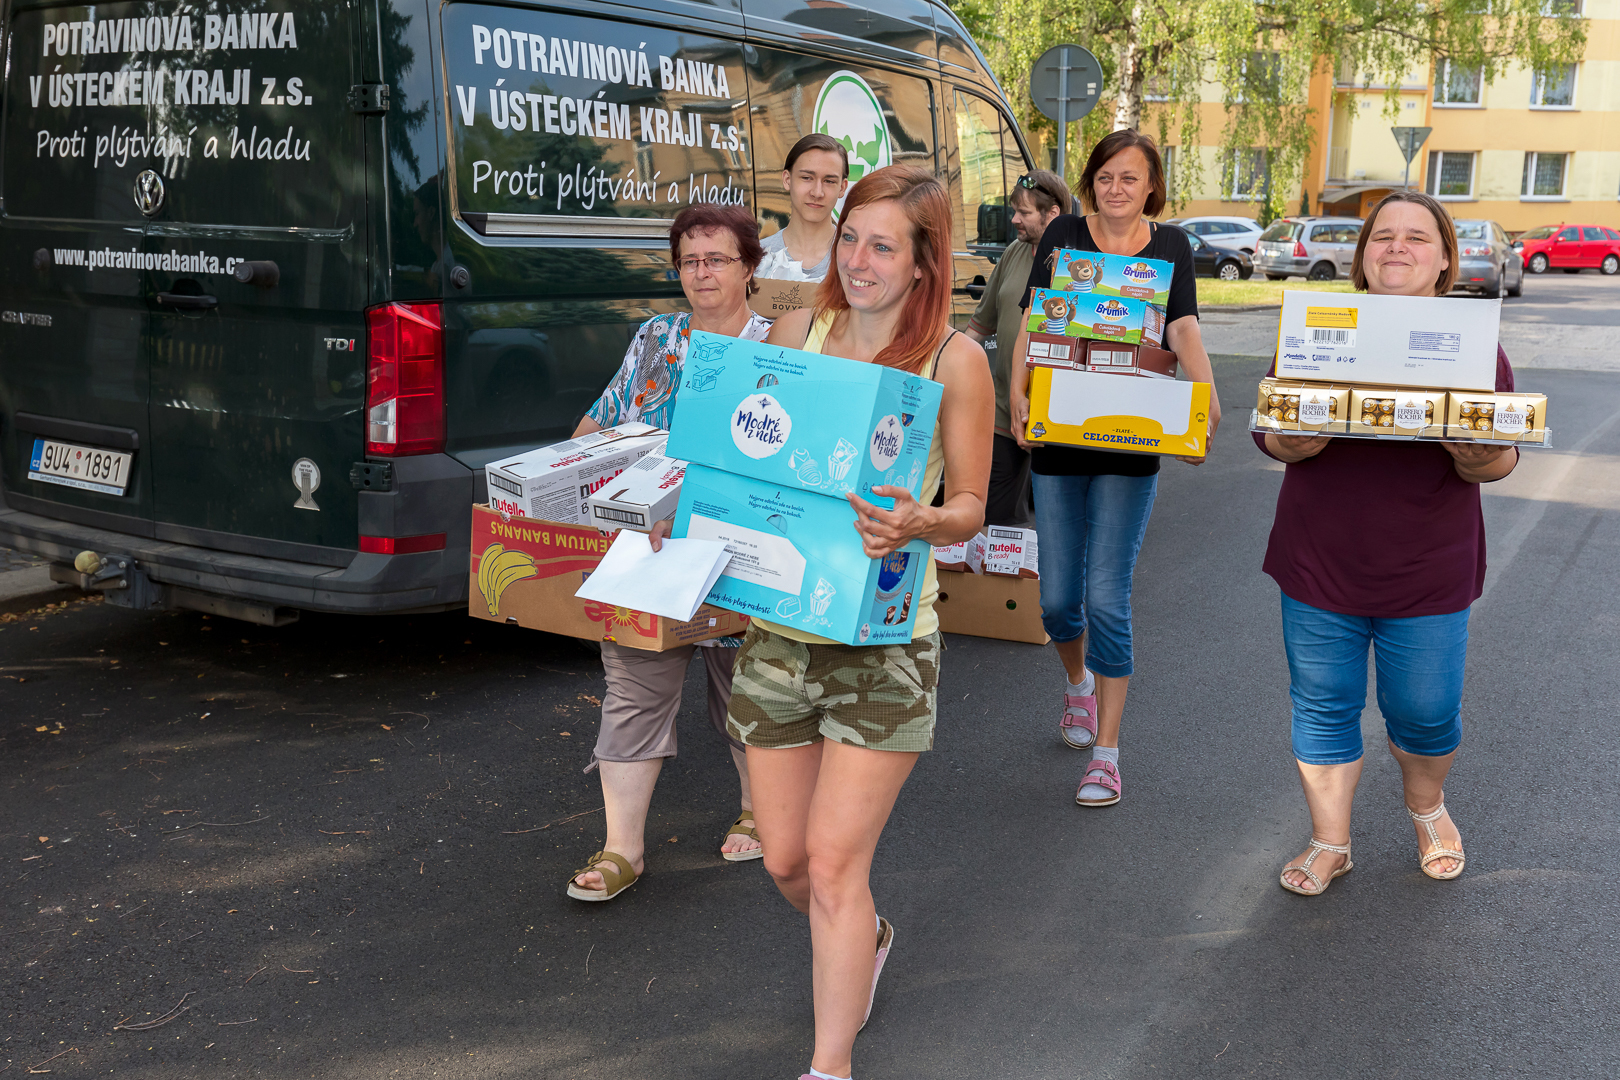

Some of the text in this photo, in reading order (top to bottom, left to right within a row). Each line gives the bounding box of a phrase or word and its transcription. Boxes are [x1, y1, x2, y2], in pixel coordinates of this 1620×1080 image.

[43, 5, 297, 57] POTRAVINOVÁ BANKA
[472, 24, 731, 99] POTRAVINOVÁ BANKA
[30, 61, 313, 108] V ÚSTECKÉM KRAJI z.s.
[456, 78, 745, 152] V ÚSTECKÉM KRAJI z.s.
[36, 125, 311, 169] Proti plýtvání a hladu
[472, 160, 745, 210] Proti plýtvání a hladu
[54, 247, 245, 275] www.potravinovabanka.c
[2, 310, 53, 327] CRAFTER
[324, 338, 356, 351] TDI
[736, 410, 780, 432] Modré
[756, 428, 784, 444] nebe
[1082, 432, 1161, 447] CELOZRNĚNKY
[32, 459, 40, 468] CZ
[44, 445, 122, 482] 9U4 1891
[550, 454, 594, 468] nutella
[775, 492, 780, 500] 1.
[490, 521, 550, 545] BANANAS
[989, 543, 1022, 553] nutella
